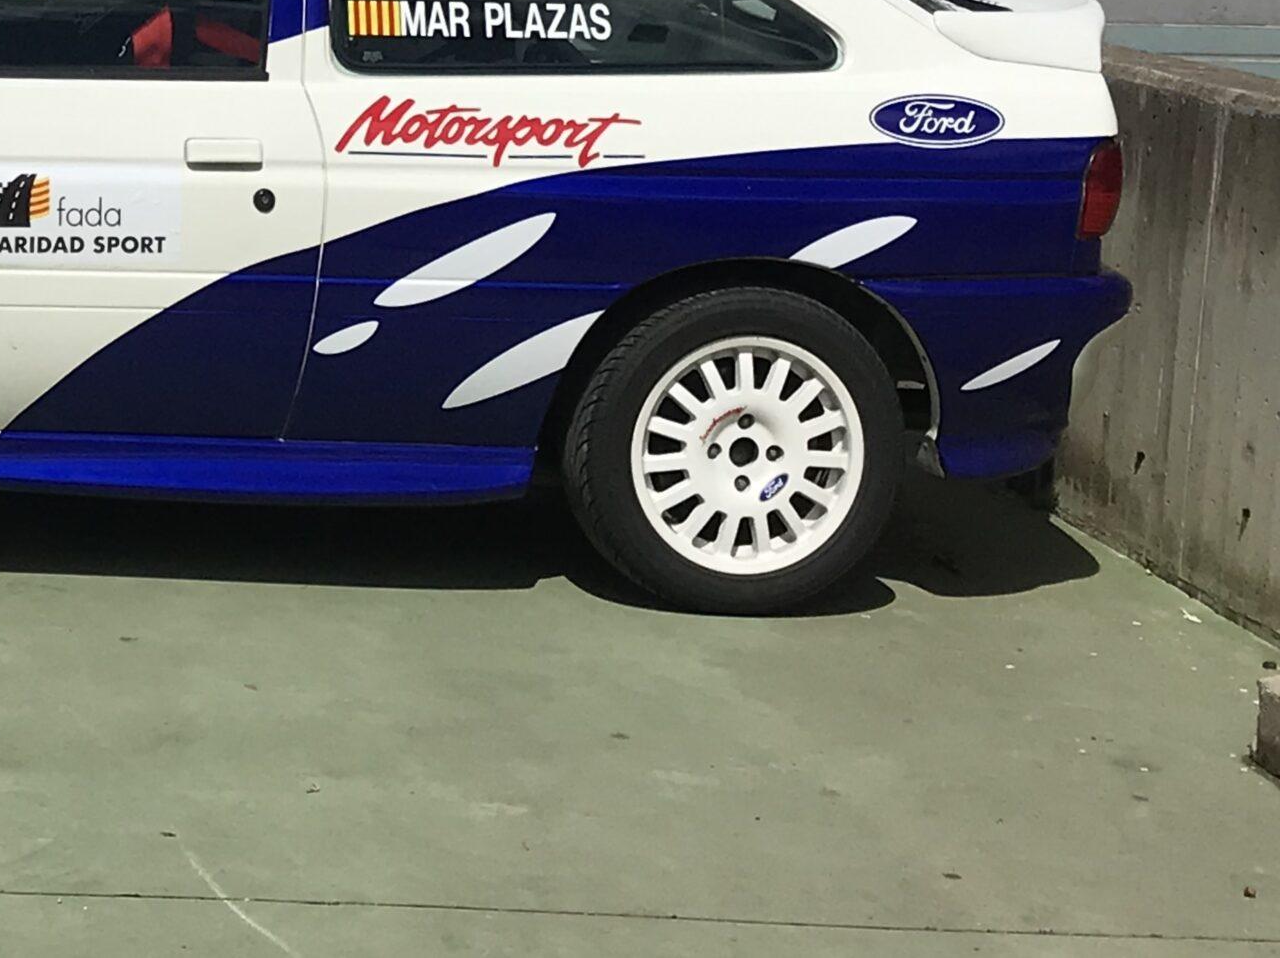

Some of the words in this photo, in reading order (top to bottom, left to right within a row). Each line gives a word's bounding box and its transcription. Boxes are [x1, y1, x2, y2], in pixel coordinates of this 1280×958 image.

[400, 0, 471, 38] MAR
[484, 2, 612, 40] PLAZAS
[334, 95, 642, 168] Motorsport
[899, 101, 976, 134] Ford
[57, 197, 121, 227] fada
[93, 236, 166, 254] SPORT
